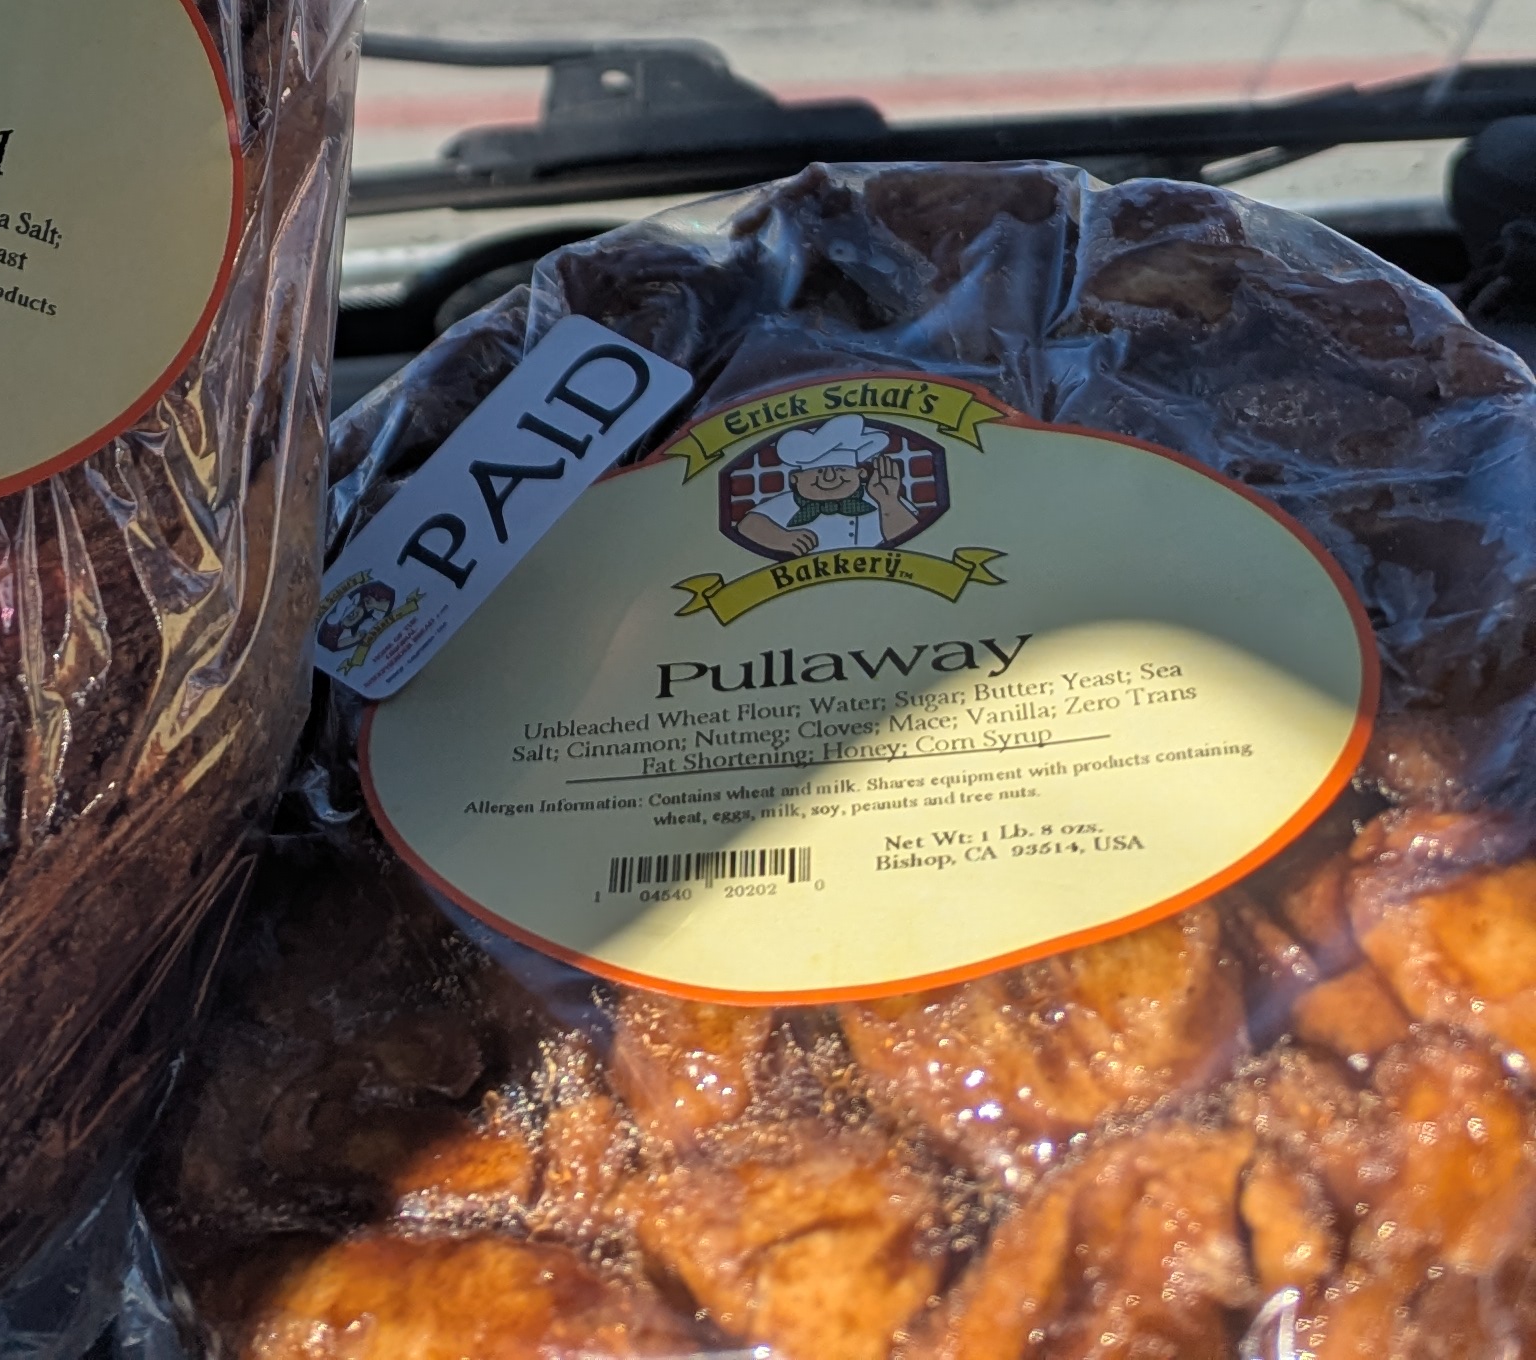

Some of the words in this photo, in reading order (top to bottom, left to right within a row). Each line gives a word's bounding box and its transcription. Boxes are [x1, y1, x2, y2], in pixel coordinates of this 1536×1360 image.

[15, 212, 63, 249] Salt;
[724, 394, 808, 435] Erick
[823, 382, 940, 415] Schat's
[396, 343, 650, 589] PAID
[656, 634, 1034, 699] Pullaway
[511, 745, 558, 763] Salt;
[566, 736, 686, 760] Cinnamon;
[694, 725, 789, 748] Nutmeg;
[798, 718, 880, 744] Cloves;
[888, 714, 958, 733] Mace;
[966, 701, 1057, 725] Vanilla;
[1064, 694, 1120, 716] Zero
[1125, 685, 1197, 706] Trans
[524, 715, 650, 741] Unbleached
[658, 706, 730, 729] Wheat
[737, 702, 800, 724] Flour;
[810, 693, 886, 716] Water;
[894, 689, 966, 712] Sugar;
[974, 681, 1054, 702] Butter;
[1061, 669, 1131, 691] Yeast;
[1140, 661, 1183, 681] Sea
[642, 756, 677, 776] Fat
[684, 747, 814, 772] Shortening;
[823, 736, 908, 763] Honey;
[915, 733, 976, 754] Corn
[982, 727, 1052, 753] Syrup
[464, 800, 534, 815] Allergen
[539, 796, 643, 815] Information:
[649, 788, 721, 808] Contains
[727, 785, 776, 800] wheat
[781, 782, 812, 797] and
[866, 776, 925, 792] Shares
[930, 766, 1023, 788] equipment
[1029, 761, 1068, 777] with
[1073, 753, 1150, 777] products
[1155, 740, 1254, 763] containing
[653, 810, 707, 827] wheat,
[851, 796, 919, 815] peanuts
[923, 791, 956, 806] and
[959, 789, 993, 803] tree
[875, 852, 957, 872] Bishop,
[965, 845, 997, 862] CA
[1094, 833, 1145, 852] USA
[885, 834, 924, 852] Net
[932, 828, 972, 847] Wt:
[981, 830, 988, 842] 1
[999, 822, 1034, 839] Lb.
[1040, 824, 1052, 835] 8
[1060, 820, 1104, 836] ozs.
[594, 890, 600, 902] 1
[724, 882, 777, 899] 20202
[815, 878, 825, 891] 0
